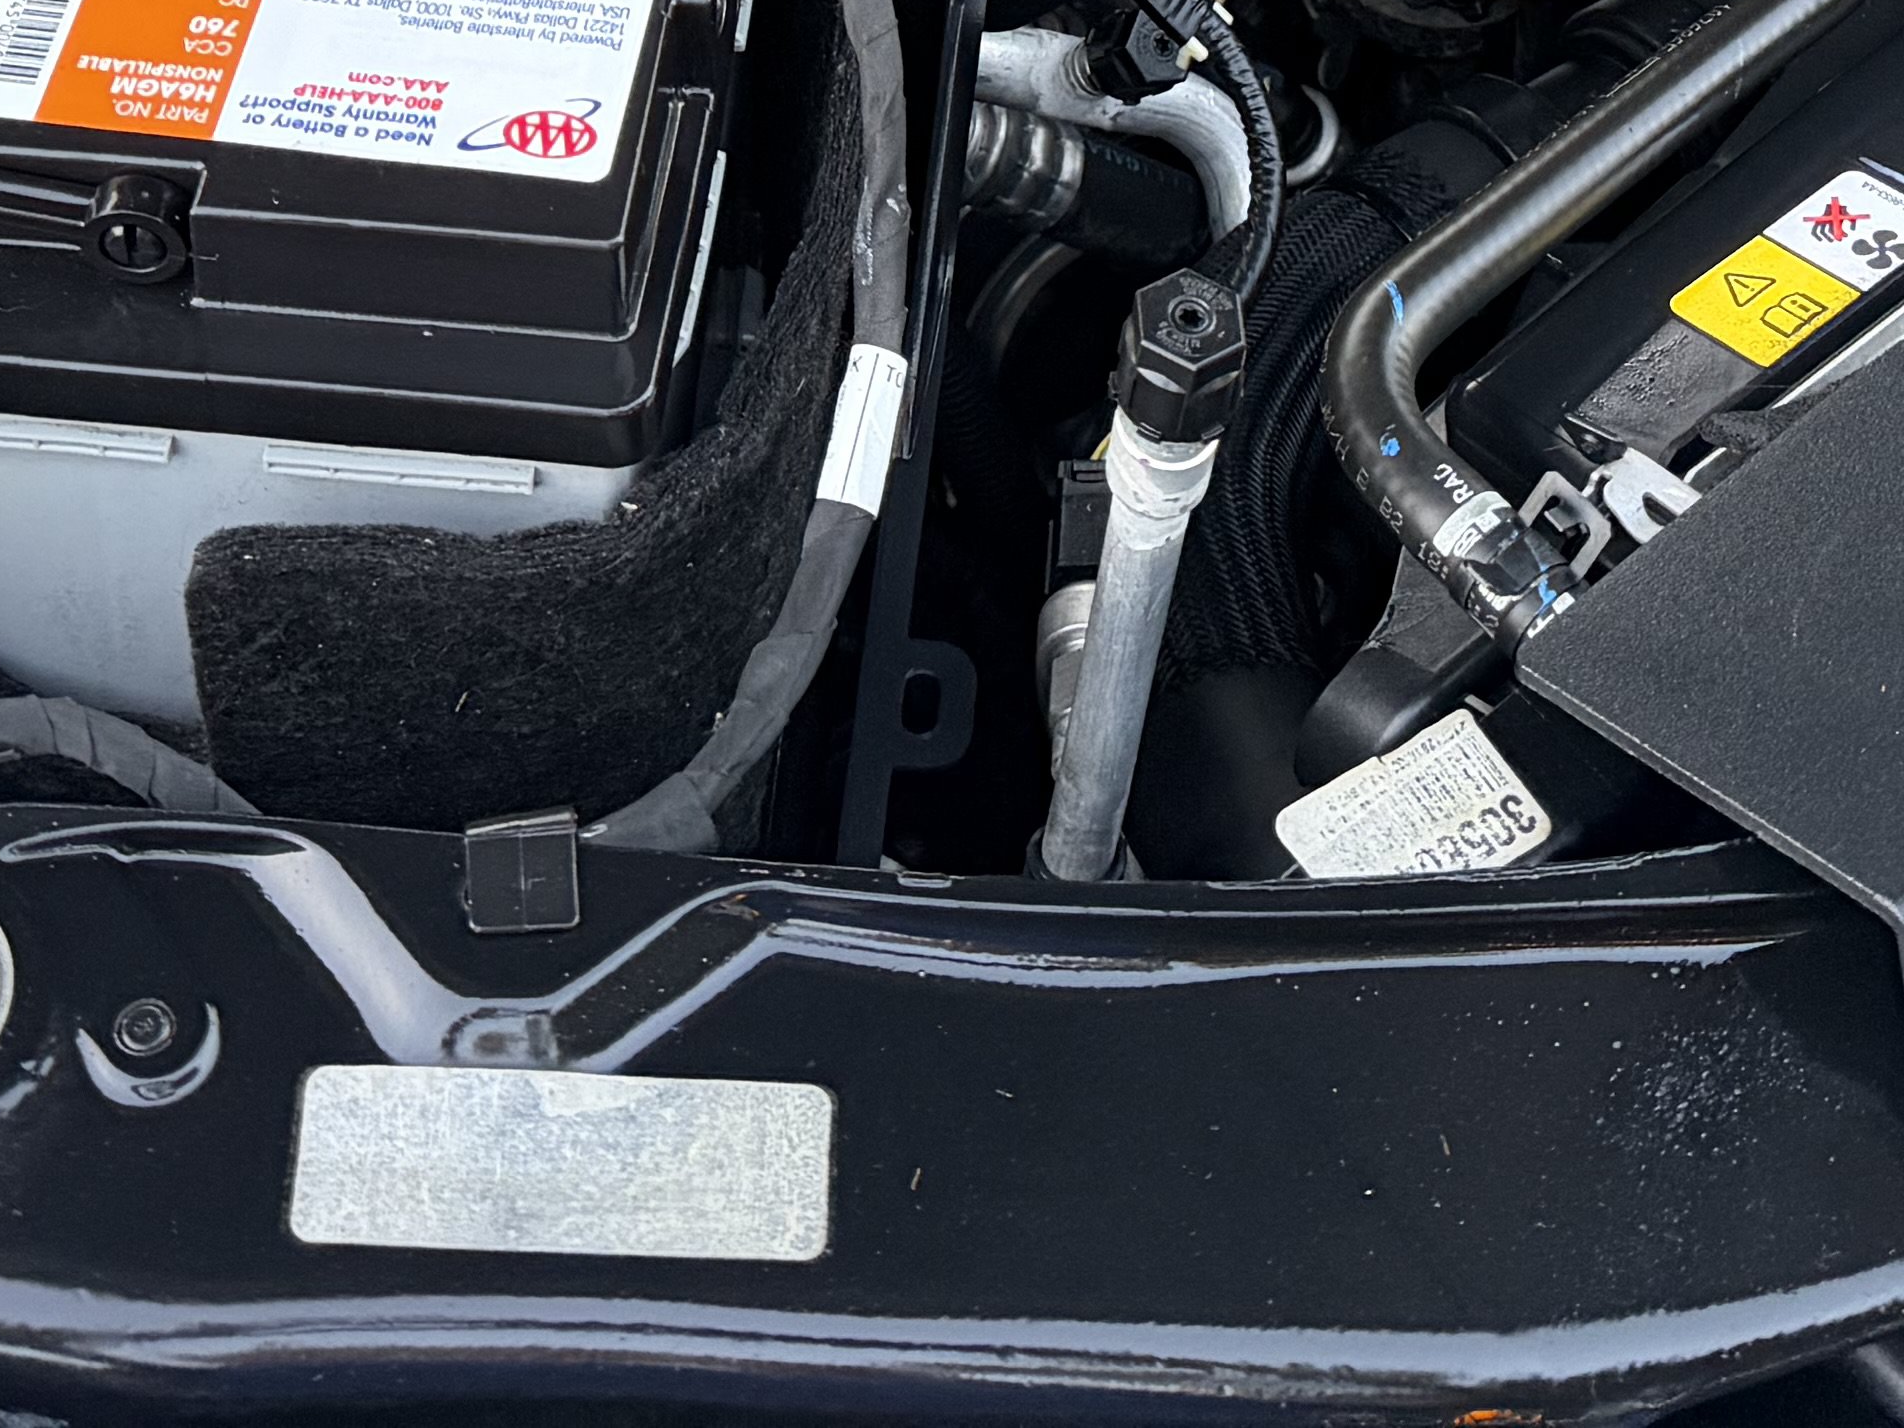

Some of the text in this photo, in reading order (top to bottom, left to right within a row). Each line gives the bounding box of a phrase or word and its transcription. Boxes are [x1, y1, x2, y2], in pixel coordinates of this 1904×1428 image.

[415, 0, 452, 16] 1000,
[458, 5, 484, 20] Ste.
[599, 3, 630, 20] USA,
[188, 15, 239, 37] 760
[397, 13, 623, 51] Powered by Interstate Batteries,
[533, 12, 578, 30] Dallas
[583, 18, 624, 35] 14221
[183, 37, 232, 56] CCA
[76, 55, 223, 82] NONSPILLABLE
[110, 75, 216, 102] H6AGM
[347, 71, 449, 93] AAA.com
[293, 83, 443, 111] 800-AAA-HELP
[112, 98, 209, 123] PART NO.
[238, 94, 436, 129] Warranty Support?
[241, 112, 433, 146] Need a Battery or
[503, 110, 593, 158] AAA
